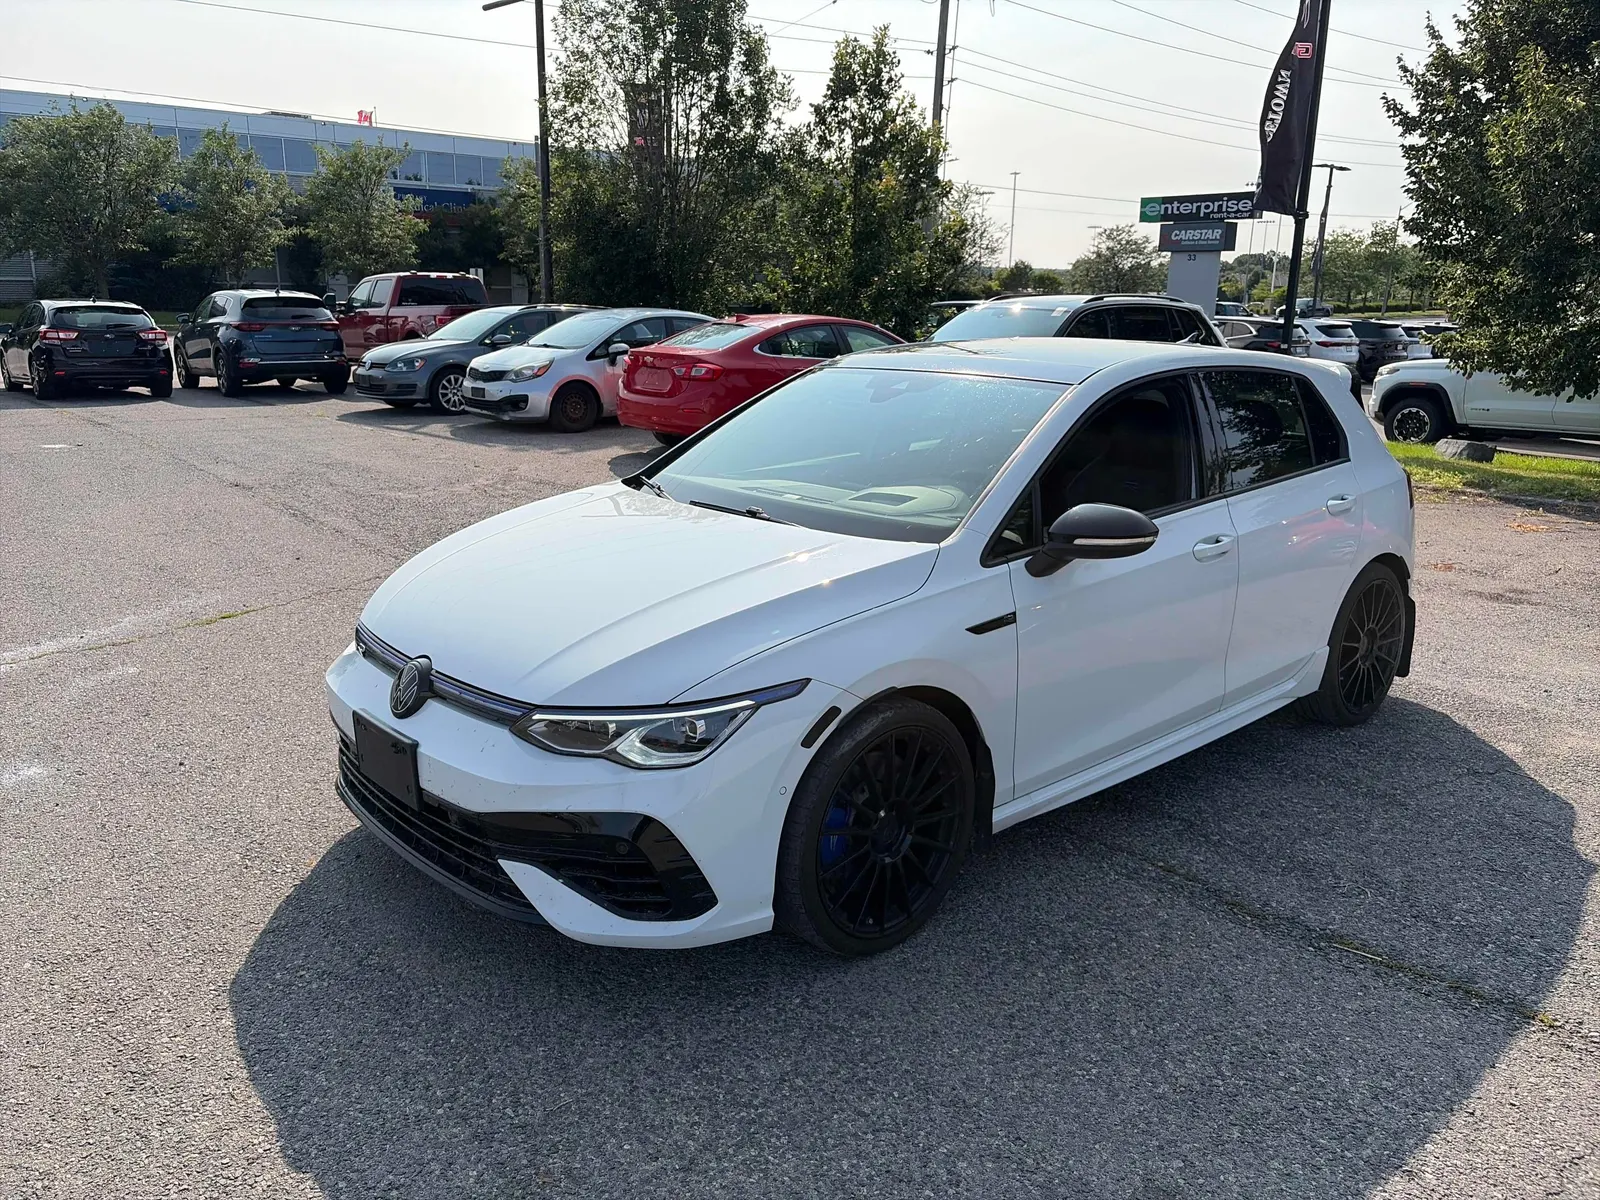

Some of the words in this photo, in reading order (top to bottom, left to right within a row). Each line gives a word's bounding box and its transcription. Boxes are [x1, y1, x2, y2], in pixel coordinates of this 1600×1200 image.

[442, 202, 467, 214] Clini
[1141, 197, 1253, 217] enterprise
[1171, 229, 1222, 241] CARSTAR
[1187, 254, 1197, 262] 33
